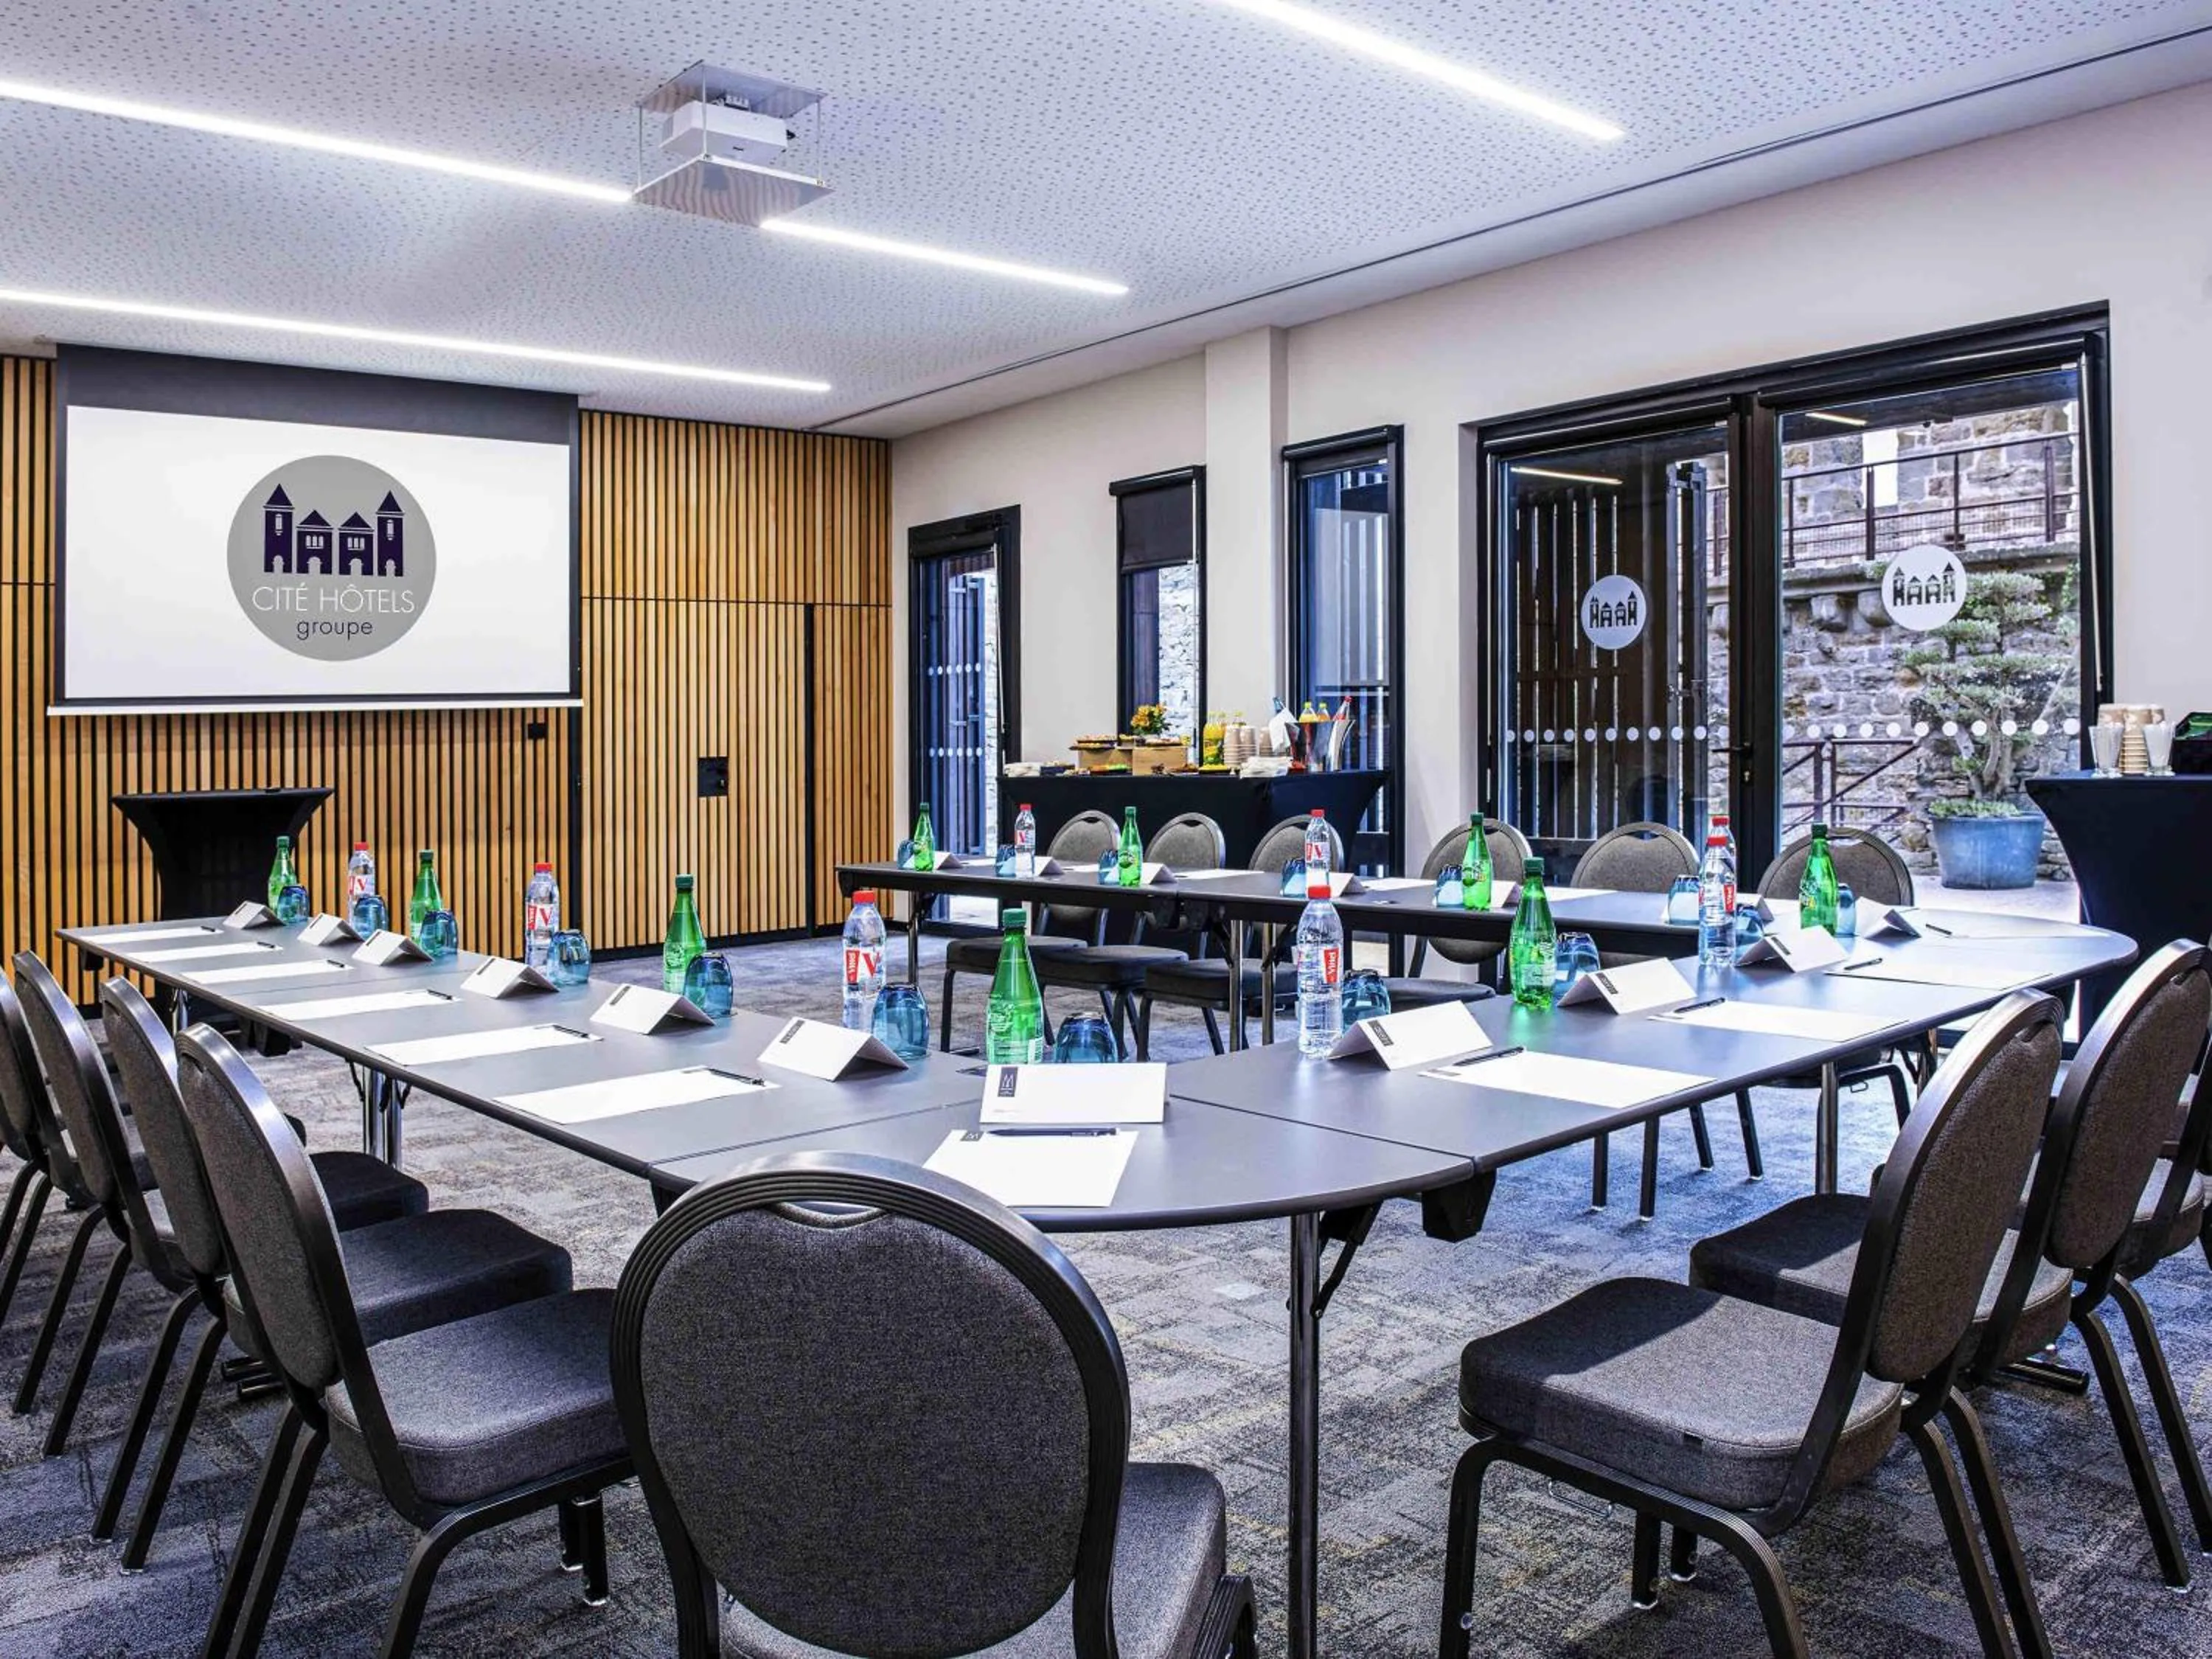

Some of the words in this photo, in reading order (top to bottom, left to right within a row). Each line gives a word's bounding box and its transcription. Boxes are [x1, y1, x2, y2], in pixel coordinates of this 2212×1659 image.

[252, 582, 308, 611] CITÉ
[319, 583, 415, 613] HÔTELS
[296, 621, 373, 641] groupe
